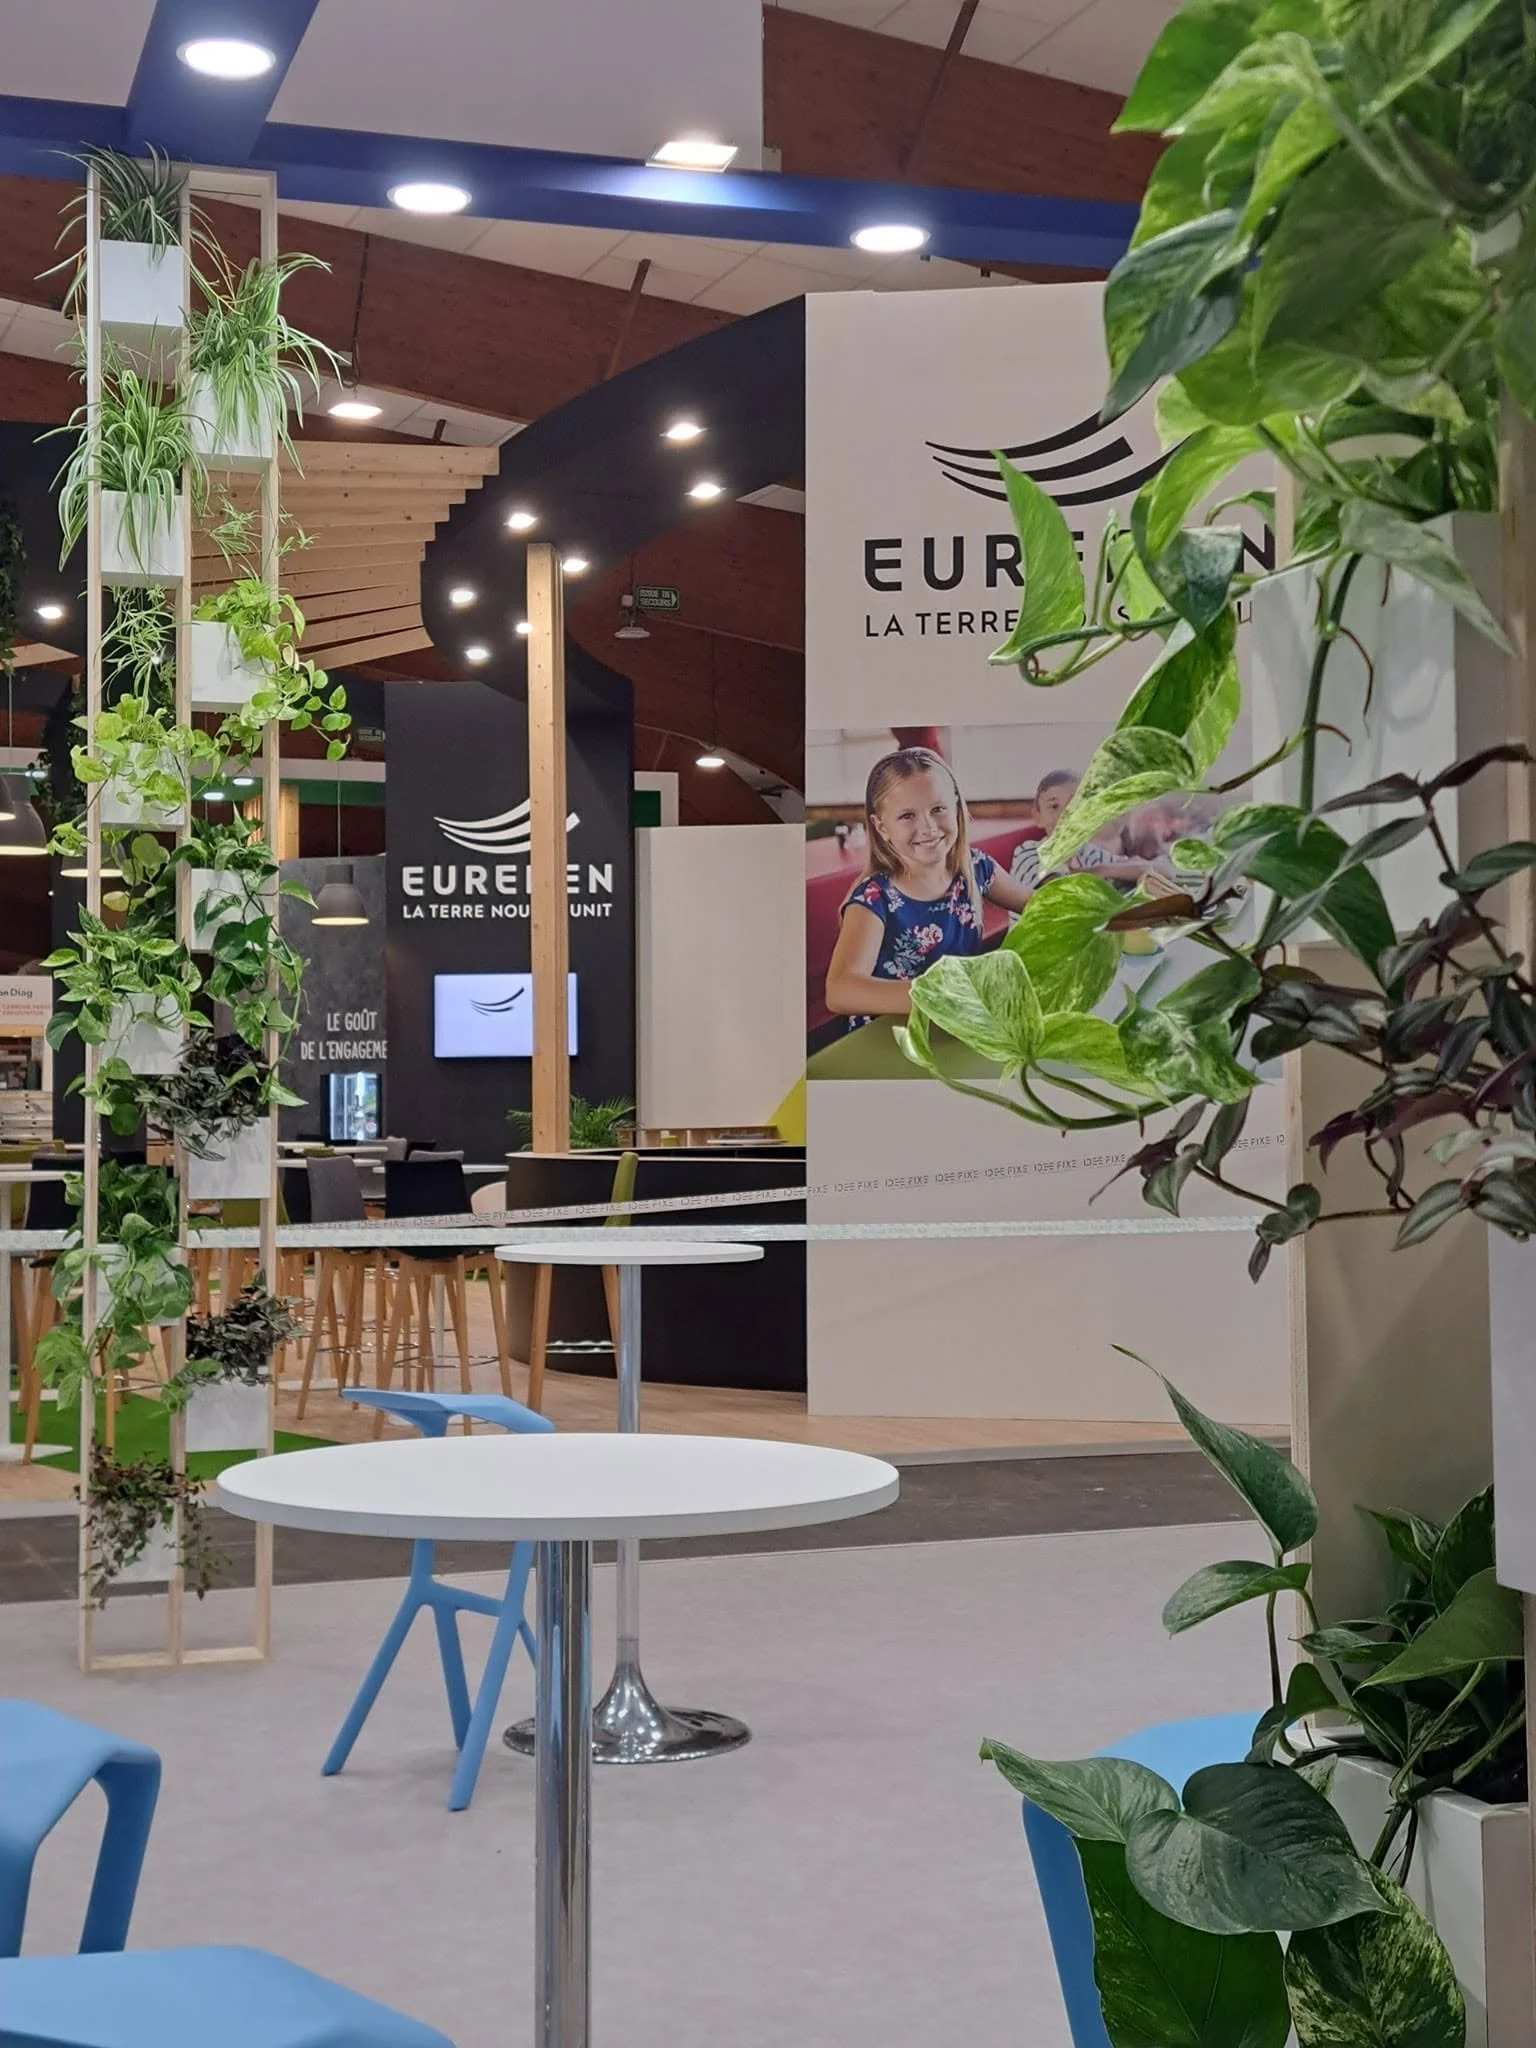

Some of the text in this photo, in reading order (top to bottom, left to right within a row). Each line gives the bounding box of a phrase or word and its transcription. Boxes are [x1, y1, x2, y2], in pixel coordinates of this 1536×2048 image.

[864, 523, 1276, 592] EURN
[865, 609, 1019, 638] LA TERRE
[402, 863, 613, 896] EUREEN
[403, 903, 613, 919] LA TERRE NOU UNIT
[327, 1008, 377, 1031] LE GOÛT
[301, 1040, 388, 1060] DE L'ENGAGEME
